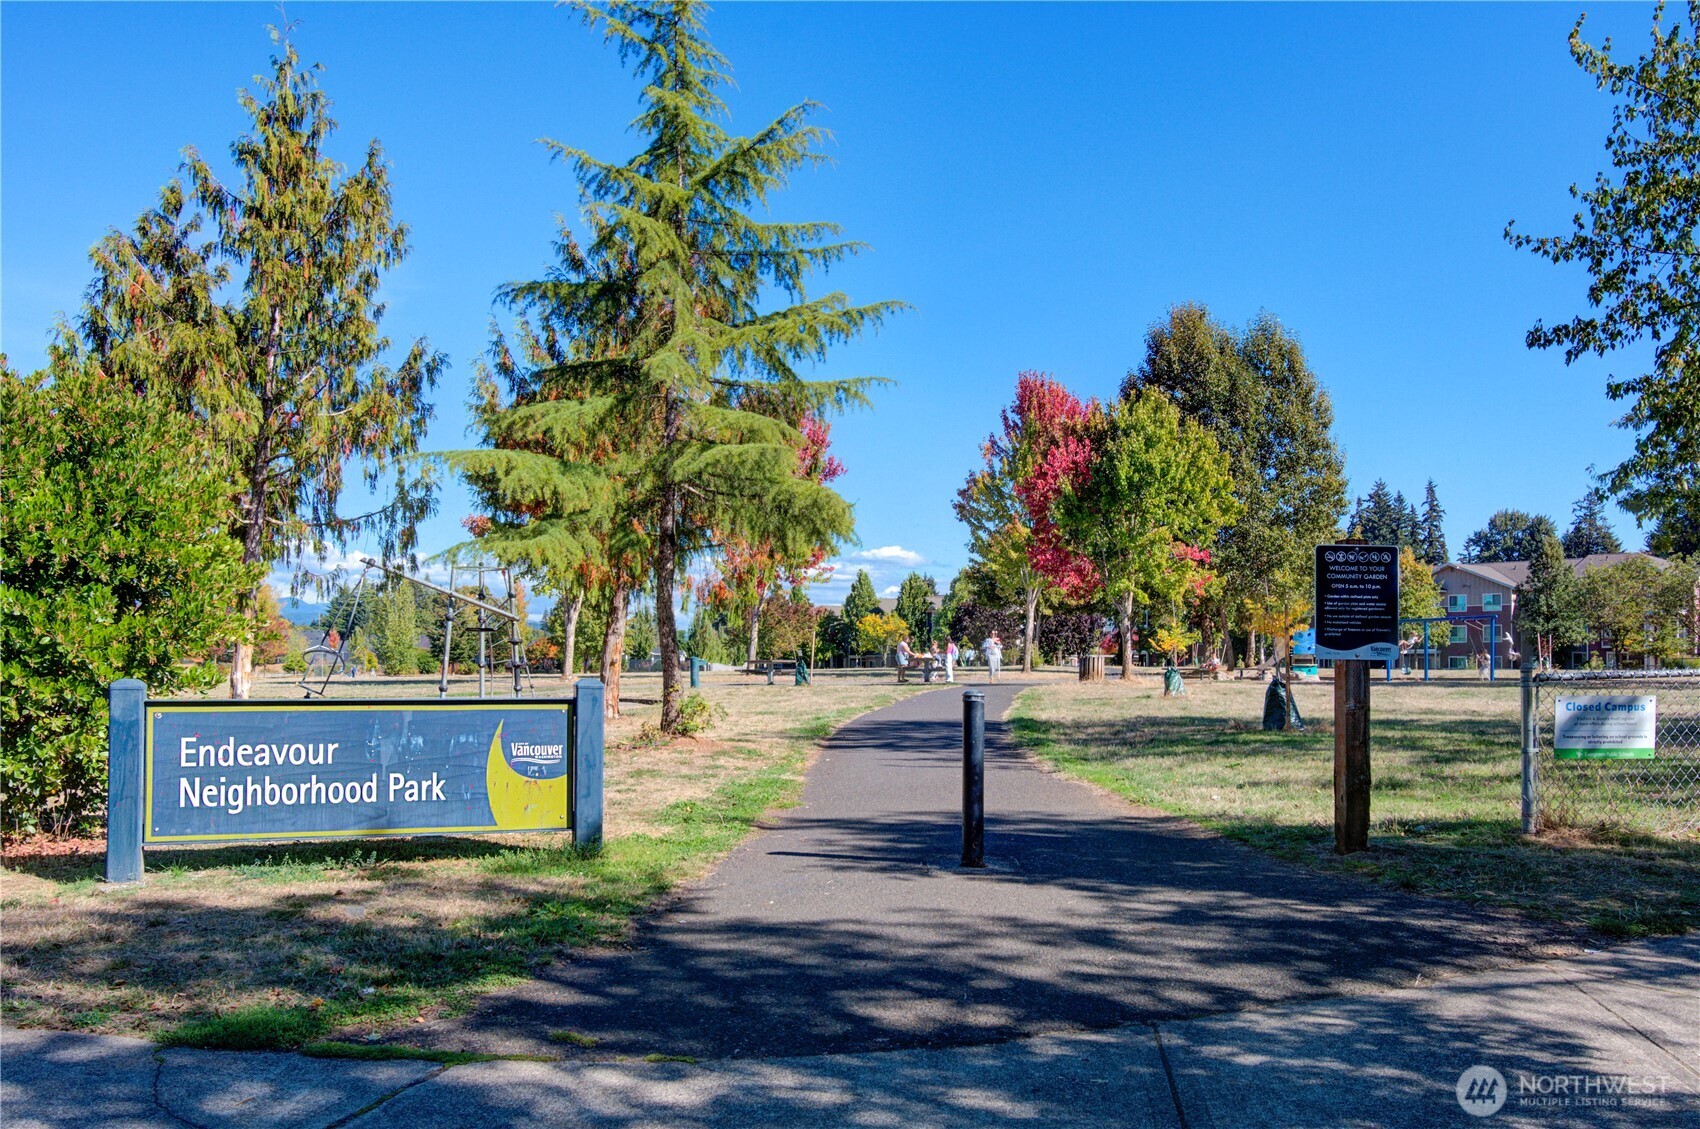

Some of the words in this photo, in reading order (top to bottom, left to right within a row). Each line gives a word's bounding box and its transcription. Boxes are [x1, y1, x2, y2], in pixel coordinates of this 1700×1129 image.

[1566, 702, 1602, 711] Closed
[1604, 702, 1646, 713] Campus
[180, 736, 338, 767] Endeavour
[511, 742, 563, 756] Vancouver
[179, 774, 378, 814] Neighborhood
[388, 772, 446, 802] Park
